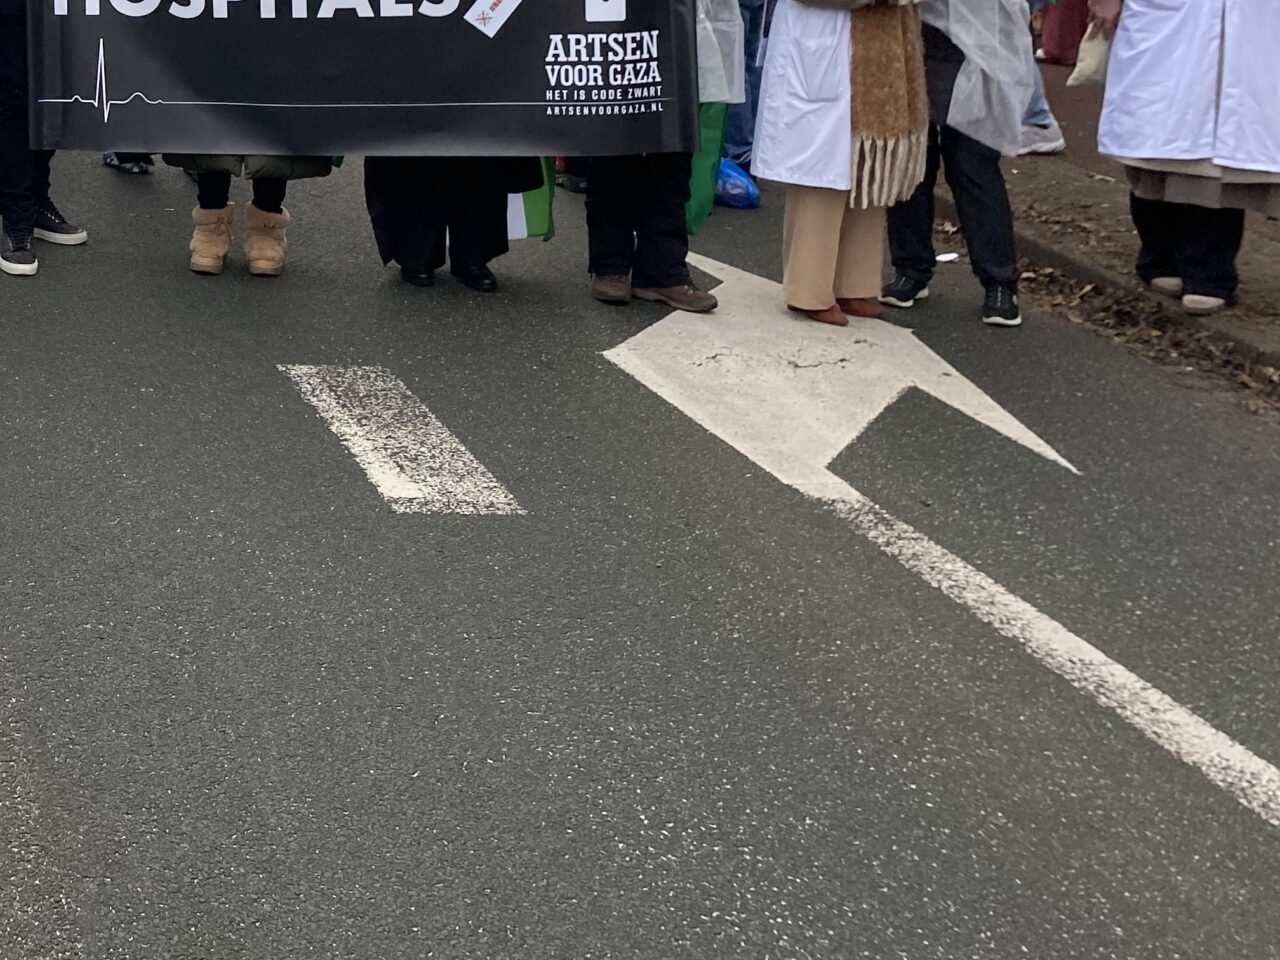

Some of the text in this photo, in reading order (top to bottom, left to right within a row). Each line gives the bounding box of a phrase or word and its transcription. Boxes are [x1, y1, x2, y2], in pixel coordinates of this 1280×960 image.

[545, 30, 659, 62] ARTSEN
[545, 61, 662, 87] VOOR GAZA
[546, 86, 662, 100] HET IS CODE ZWART
[546, 102, 664, 116] ARTSENVOORGAZA.NL
